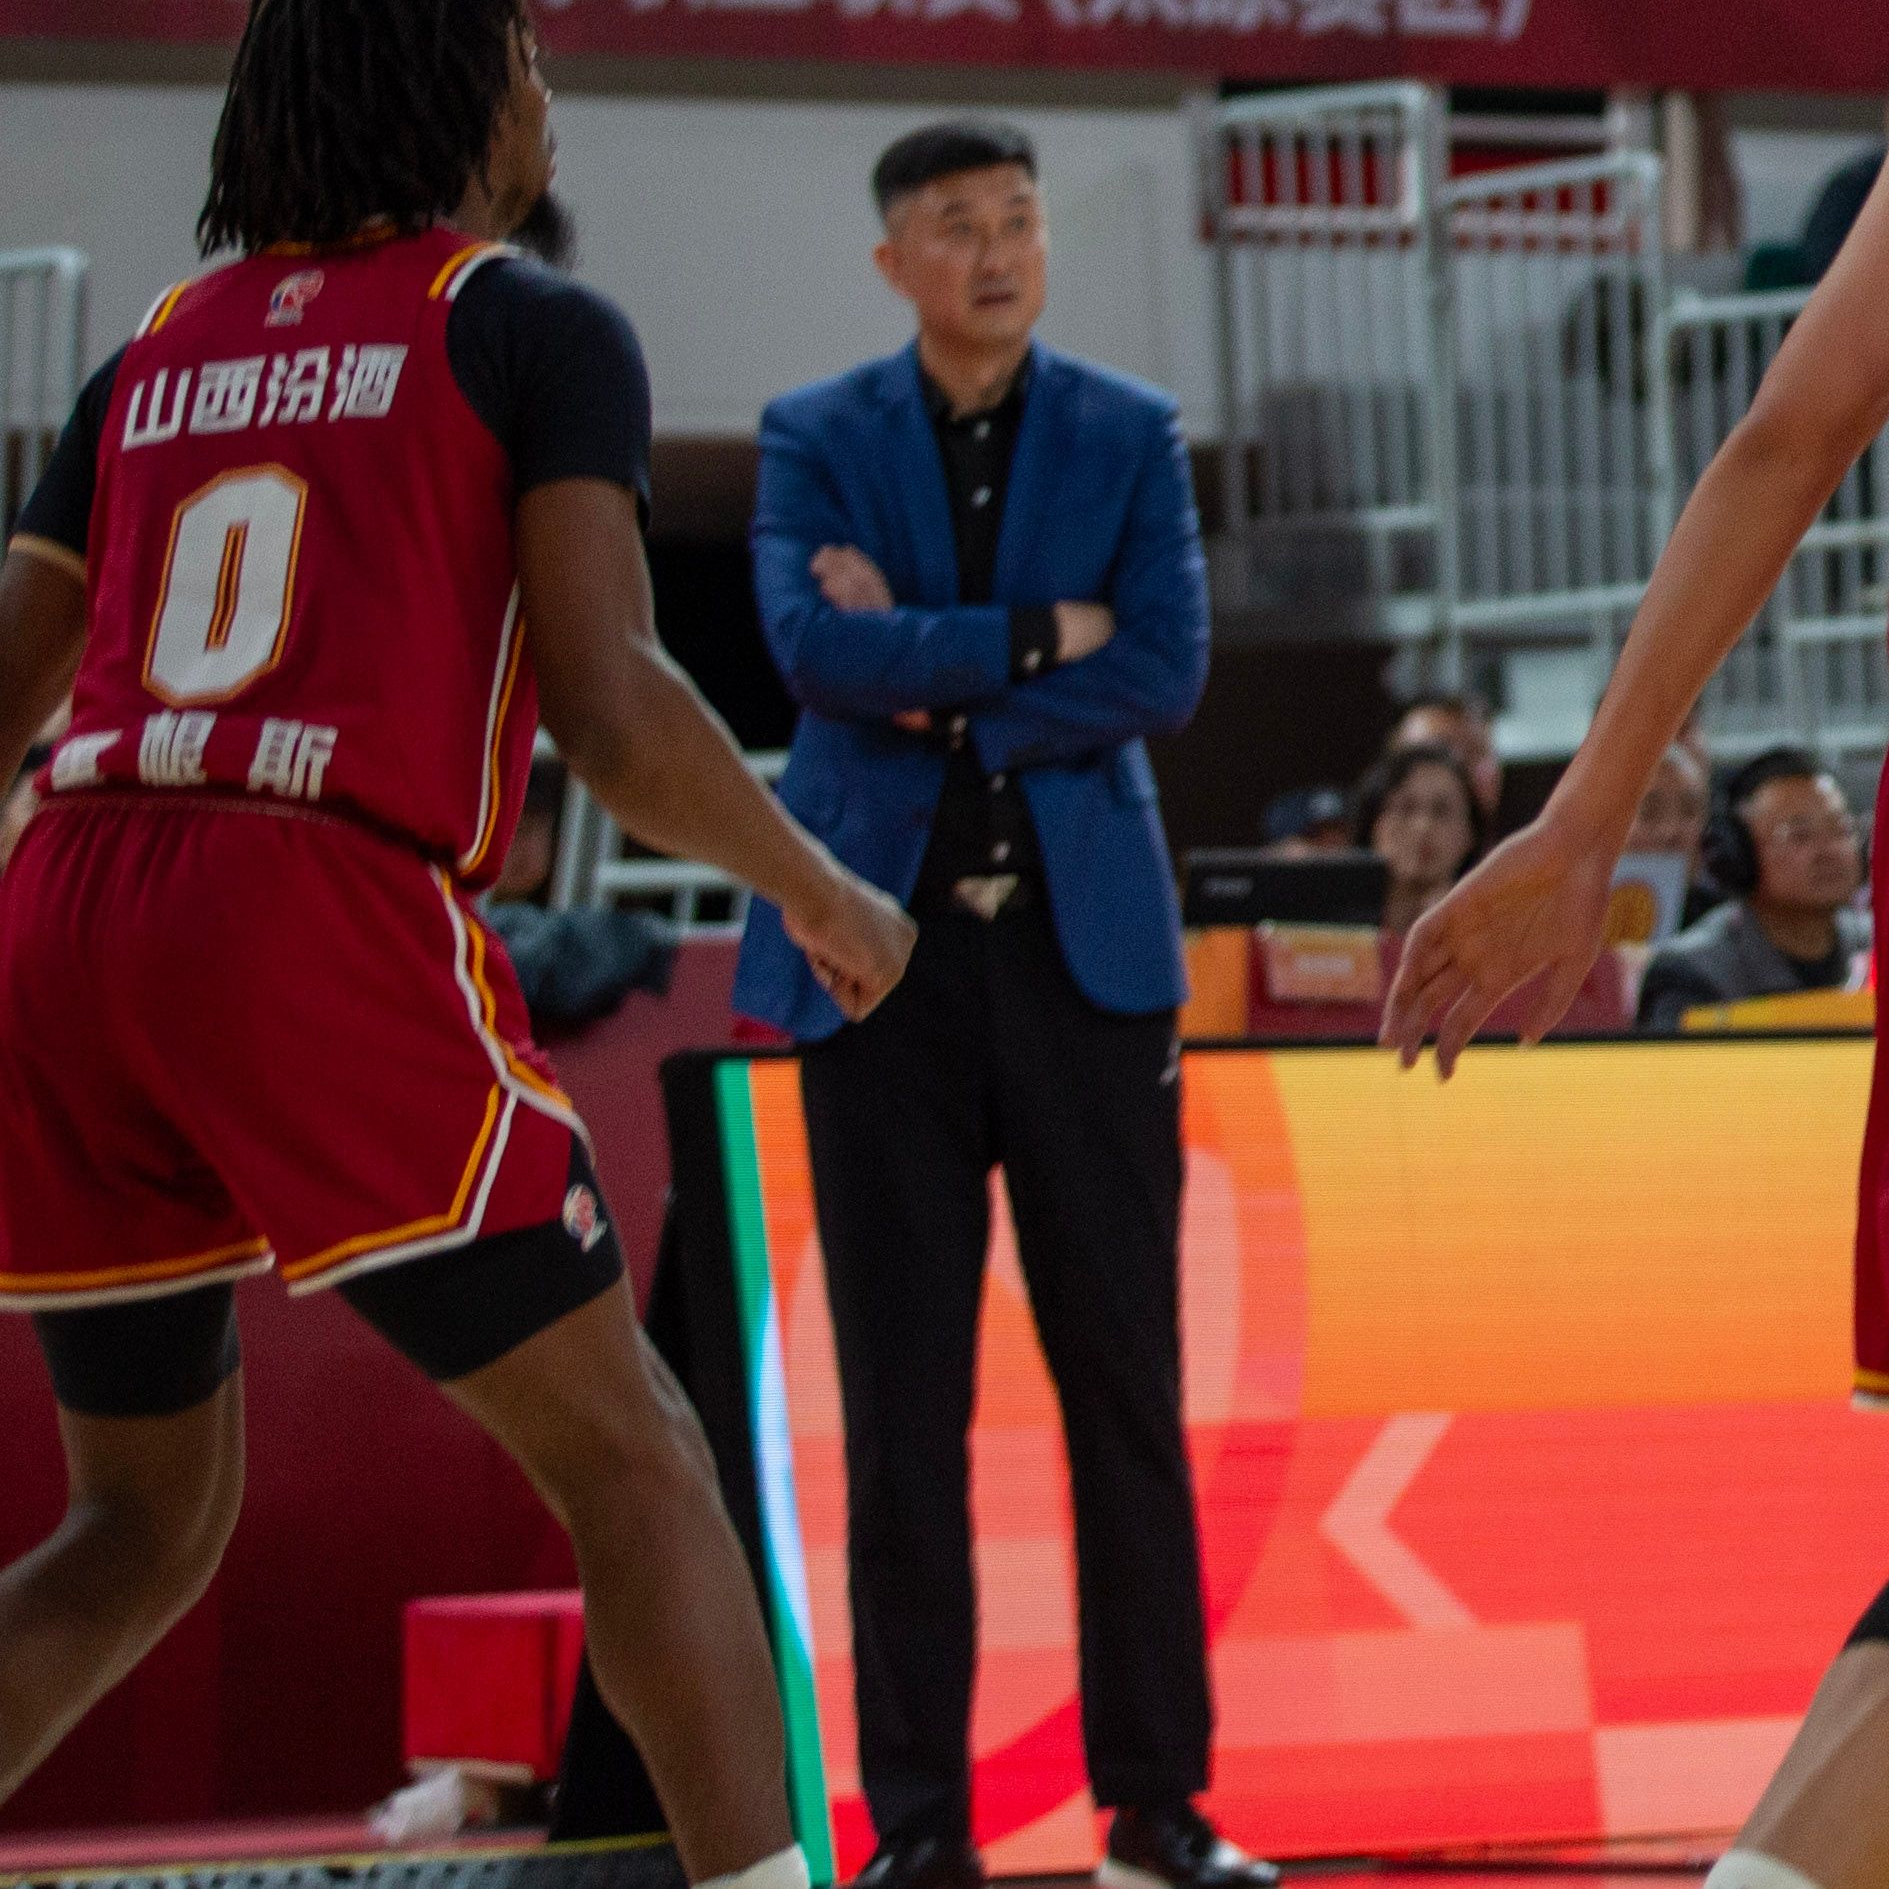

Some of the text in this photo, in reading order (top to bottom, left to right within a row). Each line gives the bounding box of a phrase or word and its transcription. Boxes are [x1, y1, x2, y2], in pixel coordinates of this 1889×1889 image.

[121, 342, 409, 451] 山西汾酒
[142, 463, 307, 708] 0
